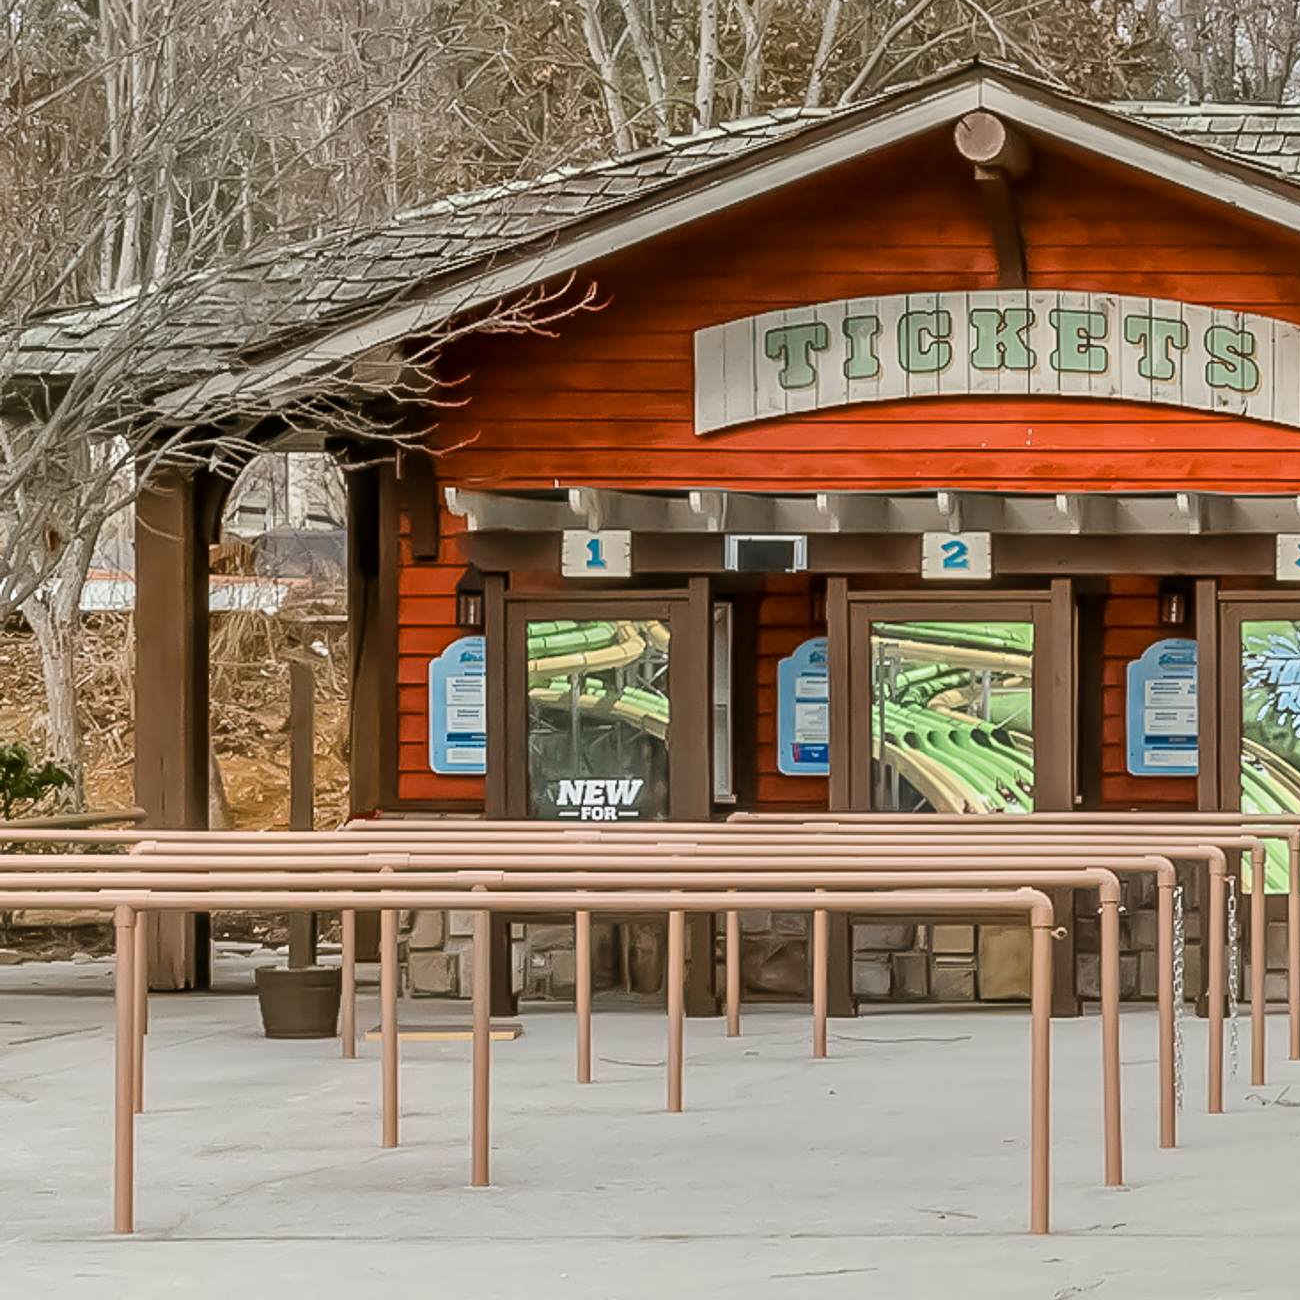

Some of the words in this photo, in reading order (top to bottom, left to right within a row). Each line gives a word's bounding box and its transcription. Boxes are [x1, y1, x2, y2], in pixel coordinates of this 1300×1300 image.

[765, 308, 1262, 395] TICKETS
[586, 538, 606, 569] 1
[941, 540, 970, 569] 2
[556, 779, 644, 806] NEW
[581, 806, 618, 821] FOR
